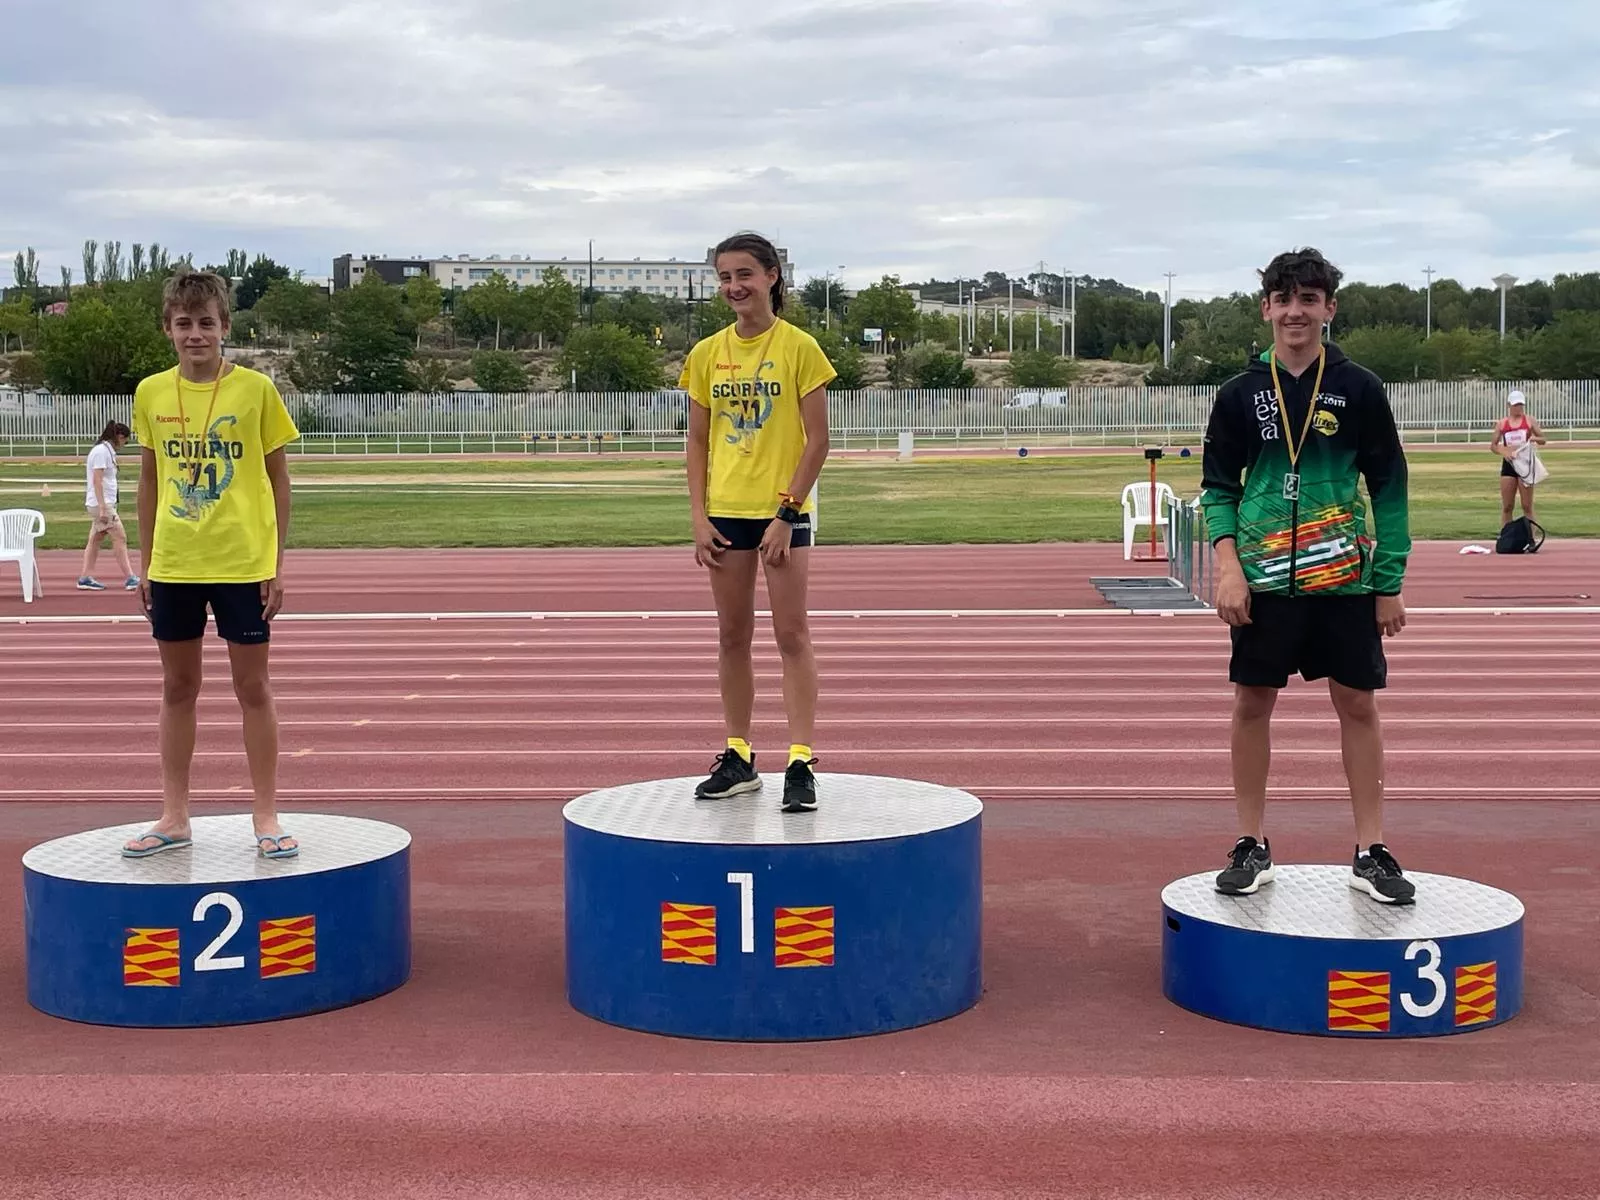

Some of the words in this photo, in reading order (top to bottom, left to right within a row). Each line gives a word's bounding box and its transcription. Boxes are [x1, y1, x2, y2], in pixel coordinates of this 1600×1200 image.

[712, 382, 781, 398] SCORPIO
[156, 414, 191, 425] Alcamo
[729, 399, 762, 429] 71
[178, 462, 220, 500] 71
[192, 892, 246, 972] 2
[727, 872, 755, 954] 1
[1399, 940, 1448, 1019] 3
